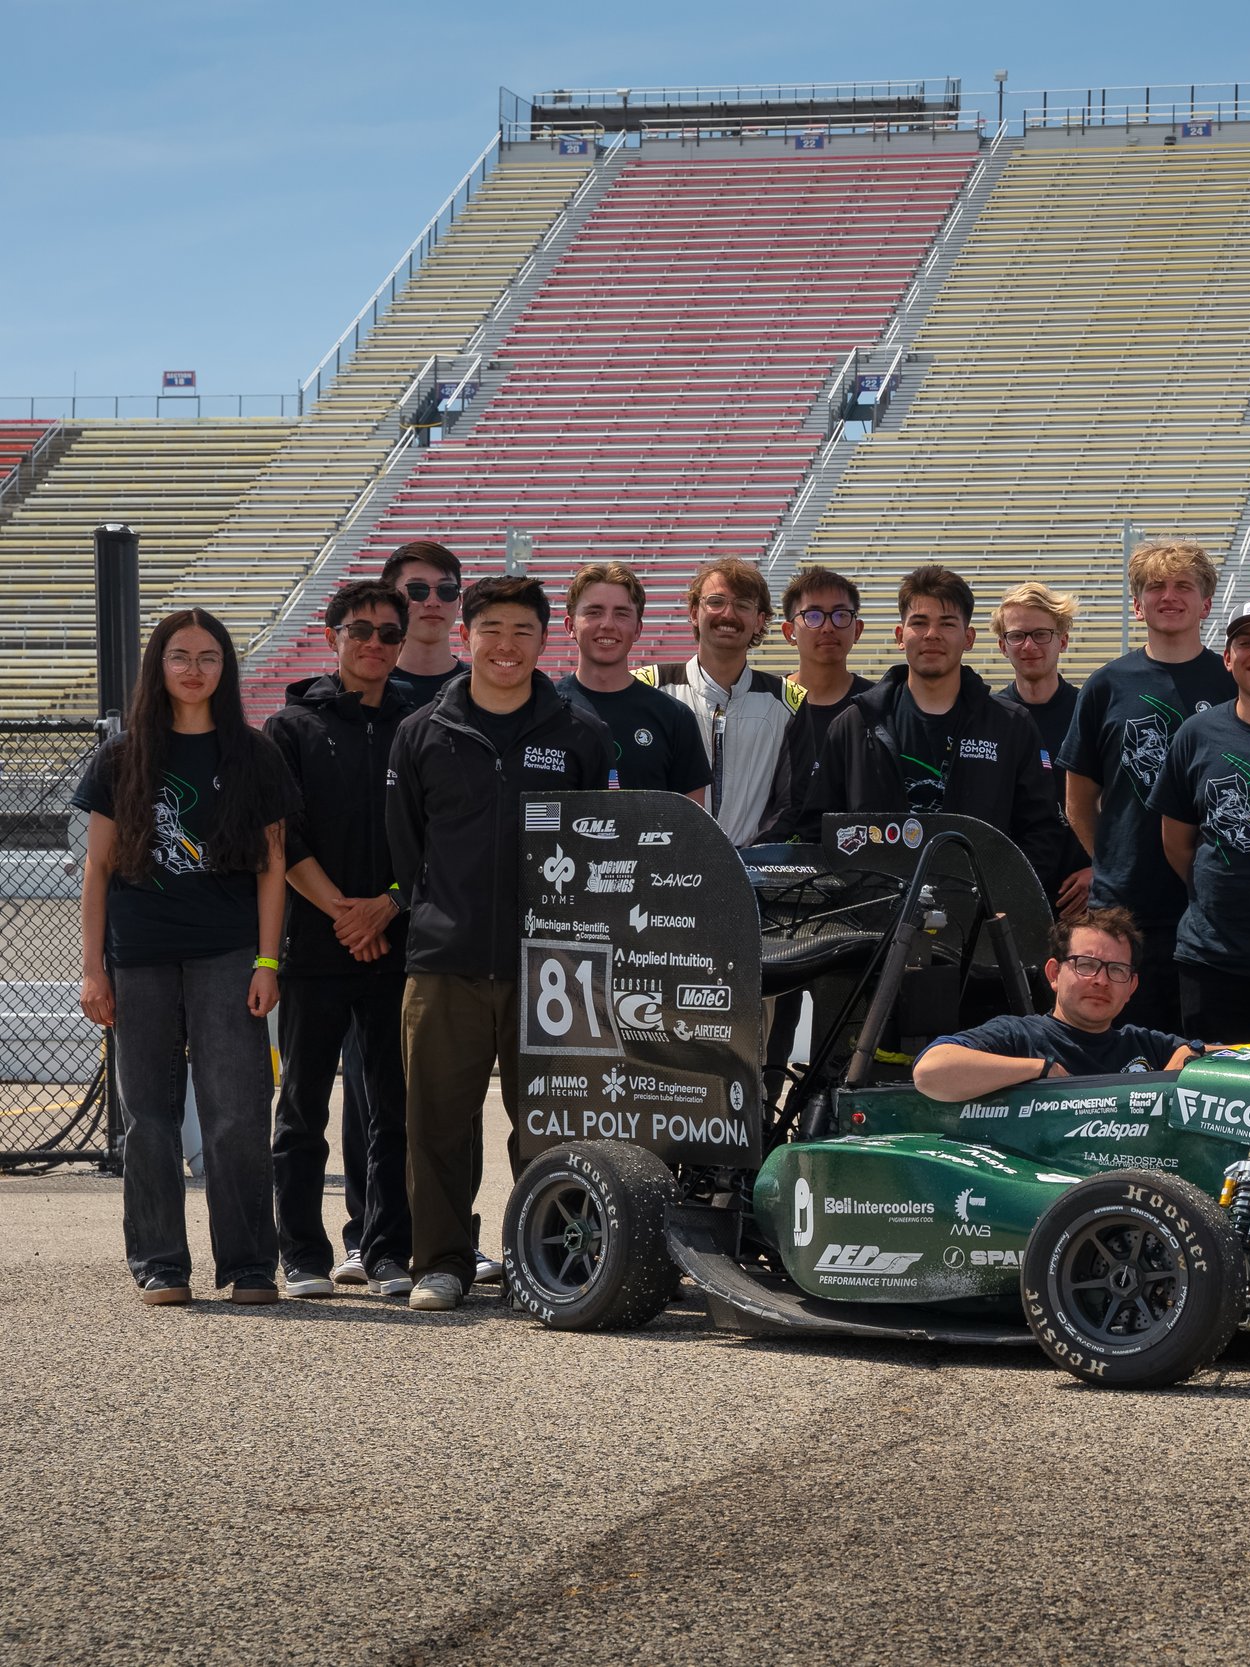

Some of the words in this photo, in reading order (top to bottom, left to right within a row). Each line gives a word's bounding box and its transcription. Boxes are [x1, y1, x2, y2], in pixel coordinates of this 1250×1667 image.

[1190, 128, 1203, 136] 24
[567, 145, 580, 154] 20
[803, 140, 816, 148] 22
[865, 380, 878, 388] 22
[960, 746, 997, 756] POMONA
[979, 740, 998, 749] POLY
[526, 746, 543, 756] CAL
[546, 748, 566, 759] POLY
[985, 754, 998, 762] SAE
[524, 754, 565, 766] POMONA
[524, 762, 551, 770] Formula
[578, 820, 617, 833] D.M.E.
[638, 832, 673, 845] HPS
[600, 860, 638, 874] DOWNEY
[757, 865, 818, 874] MOTORSPORTS
[598, 879, 635, 893] VIKINGS
[650, 873, 703, 887] DANCO
[542, 894, 575, 905] DYME
[536, 918, 571, 933] Michigan
[572, 921, 610, 933] Scientific
[650, 916, 696, 929] HEXAGON
[628, 950, 667, 968] Applied
[670, 952, 713, 968] Intuition
[613, 978, 662, 991] COASTAL
[536, 958, 601, 1038] 81
[682, 988, 726, 1006] MoTeC
[620, 1030, 670, 1043] ENTERPRISES
[694, 1024, 732, 1039] AIRTECH
[552, 1076, 588, 1089] MIMO
[629, 1076, 656, 1091] VR3
[658, 1082, 707, 1097] Engineering
[660, 1094, 674, 1102] tube
[674, 1095, 704, 1104] fabrication
[1130, 1092, 1157, 1100] Strong
[1034, 1101, 1060, 1112] DAVID
[1060, 1097, 1118, 1110] ENGINEERING
[1079, 1107, 1118, 1115] MANUFACTURING
[1130, 1107, 1145, 1115] Tools
[960, 1104, 1010, 1119] Altium
[527, 1110, 576, 1136] CAL
[584, 1110, 640, 1139] POLY
[652, 1114, 749, 1148] POMONA
[1087, 1120, 1150, 1141] Calspan
[1200, 1121, 1234, 1135] TITANIUM
[1112, 1154, 1179, 1168] AEROSPACE
[824, 1198, 852, 1214] Bell
[854, 1200, 935, 1215] Intercoolers
[1130, 1208, 1159, 1224] RACING
[819, 1275, 880, 1287] PERFORMANCE
[881, 1278, 918, 1287] TUNING
[1076, 1336, 1105, 1353] RACING
